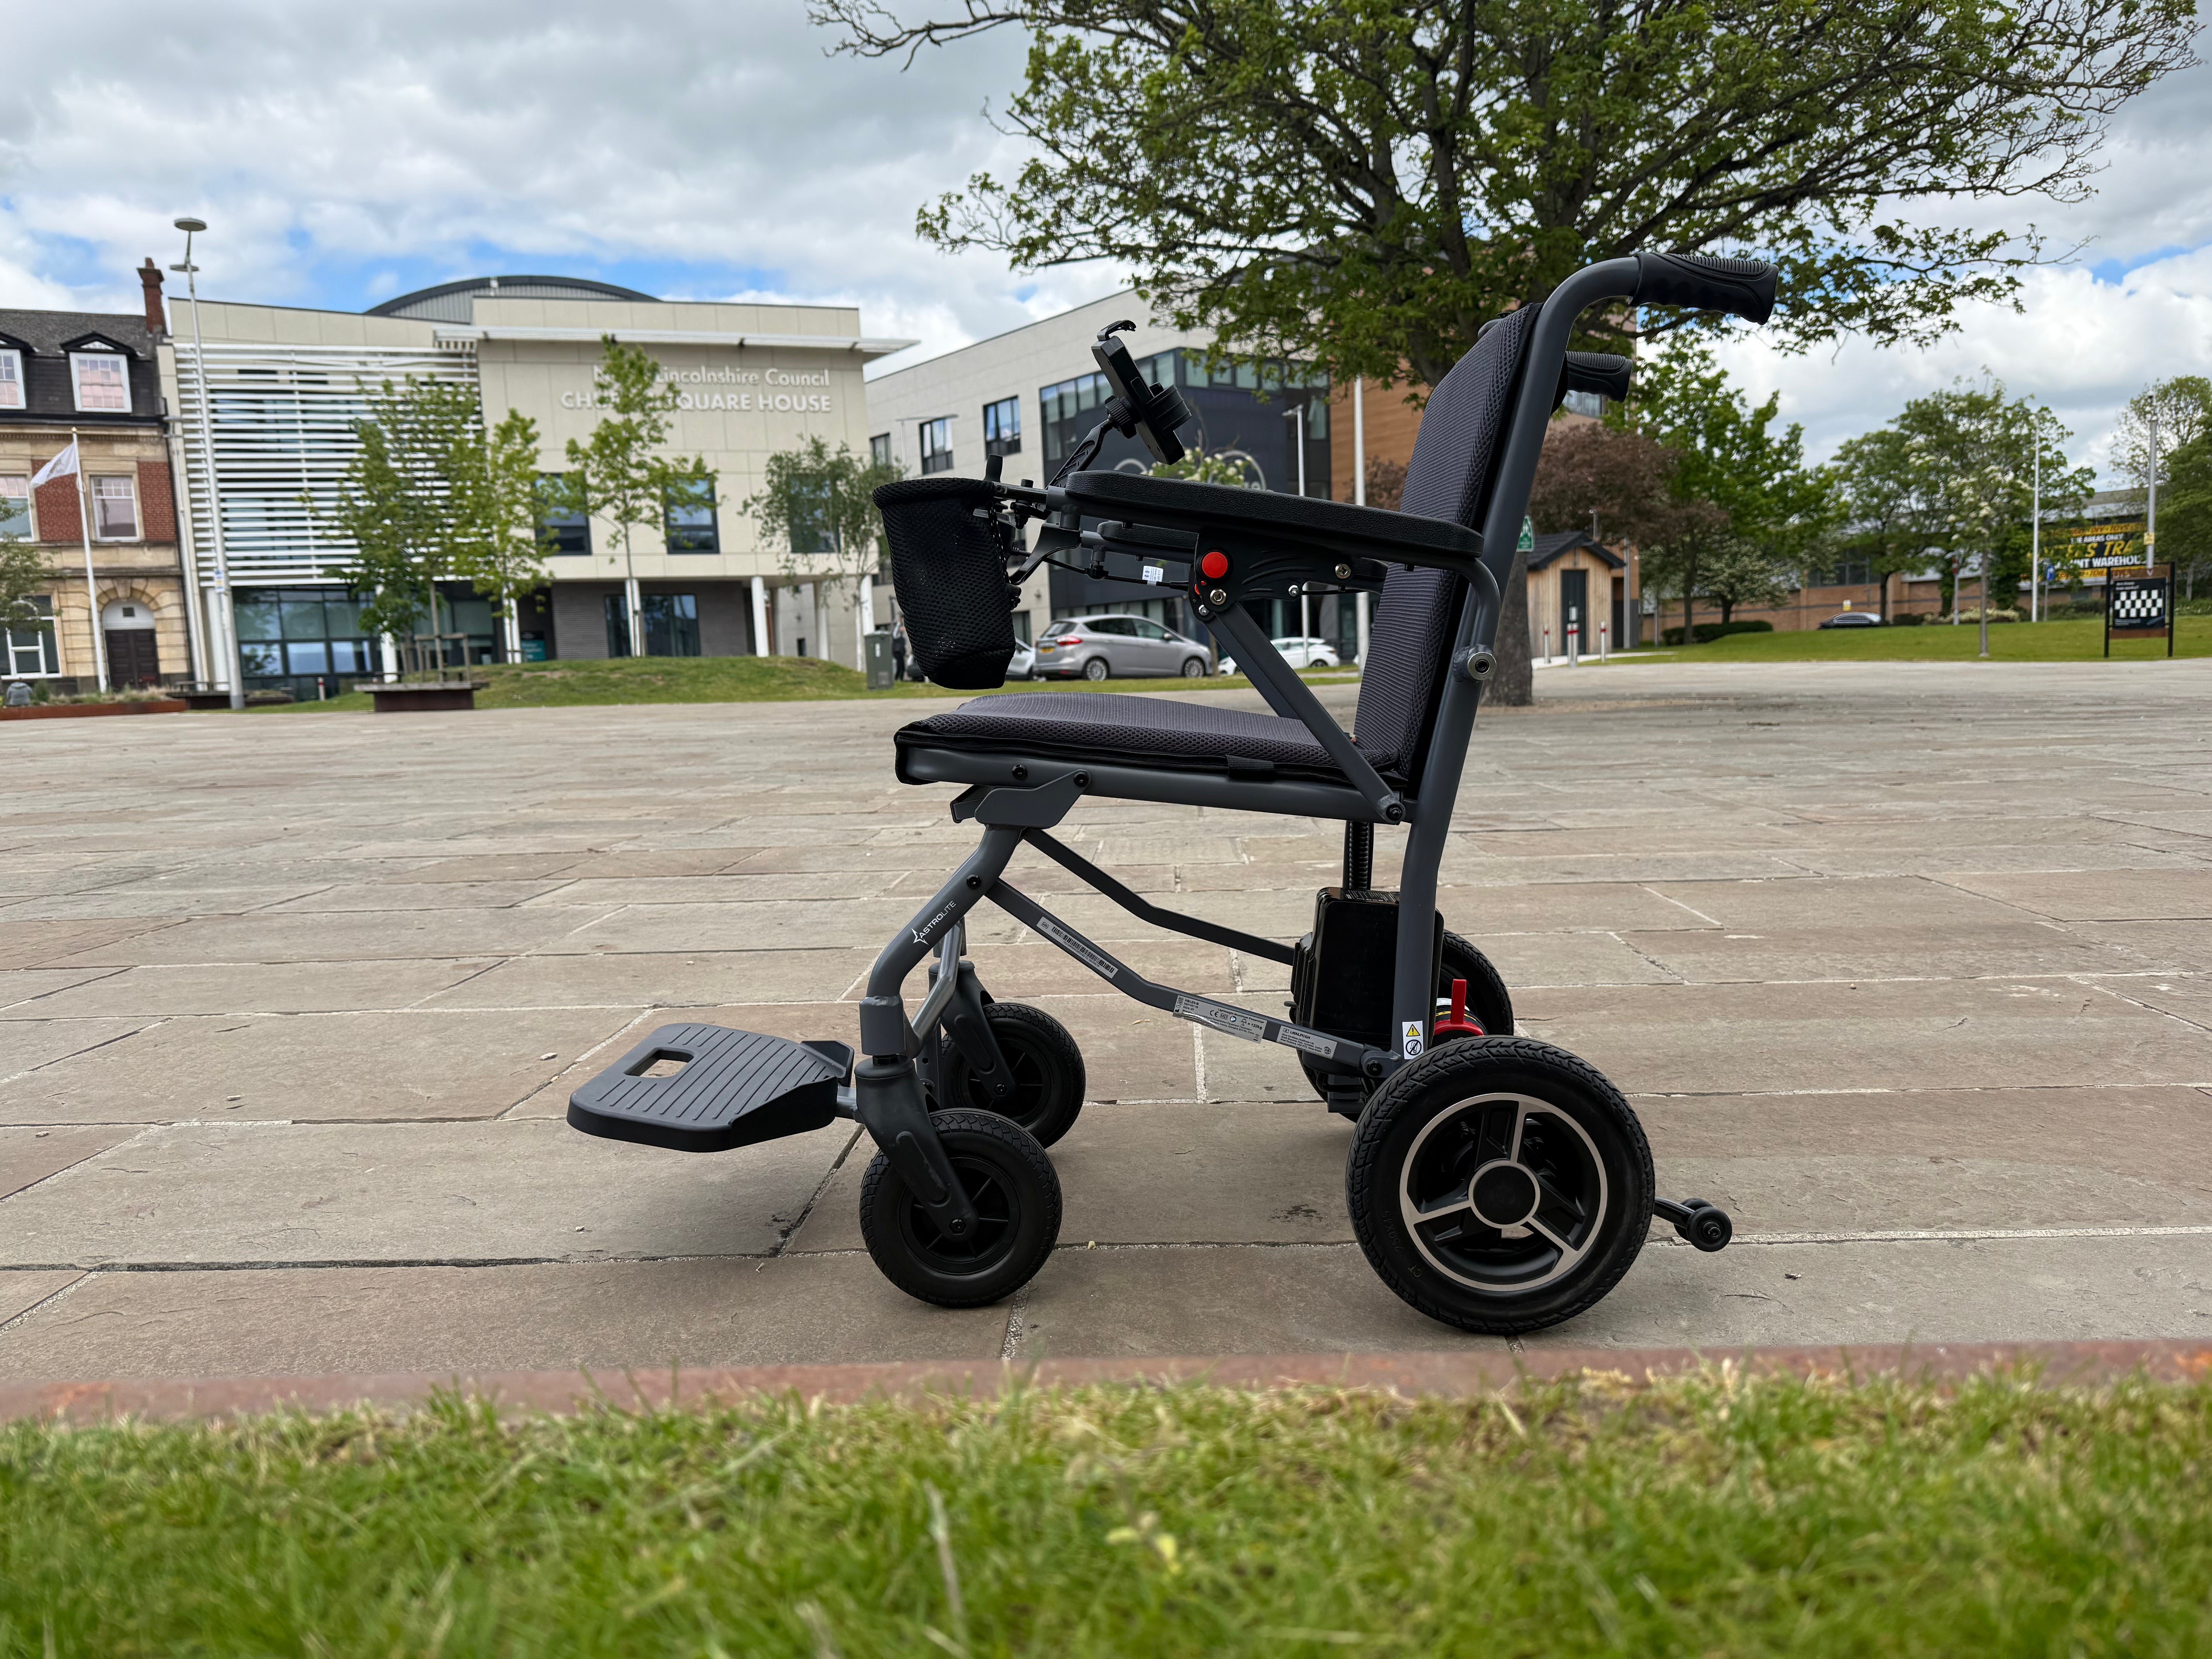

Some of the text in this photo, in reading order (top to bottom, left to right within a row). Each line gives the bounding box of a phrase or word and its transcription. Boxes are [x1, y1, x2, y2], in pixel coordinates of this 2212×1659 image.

[765, 368, 830, 386] Council
[759, 394, 831, 412] HOUSE
[919, 901, 956, 939] ASTROLITE
[1408, 1265, 1422, 1278] CT
